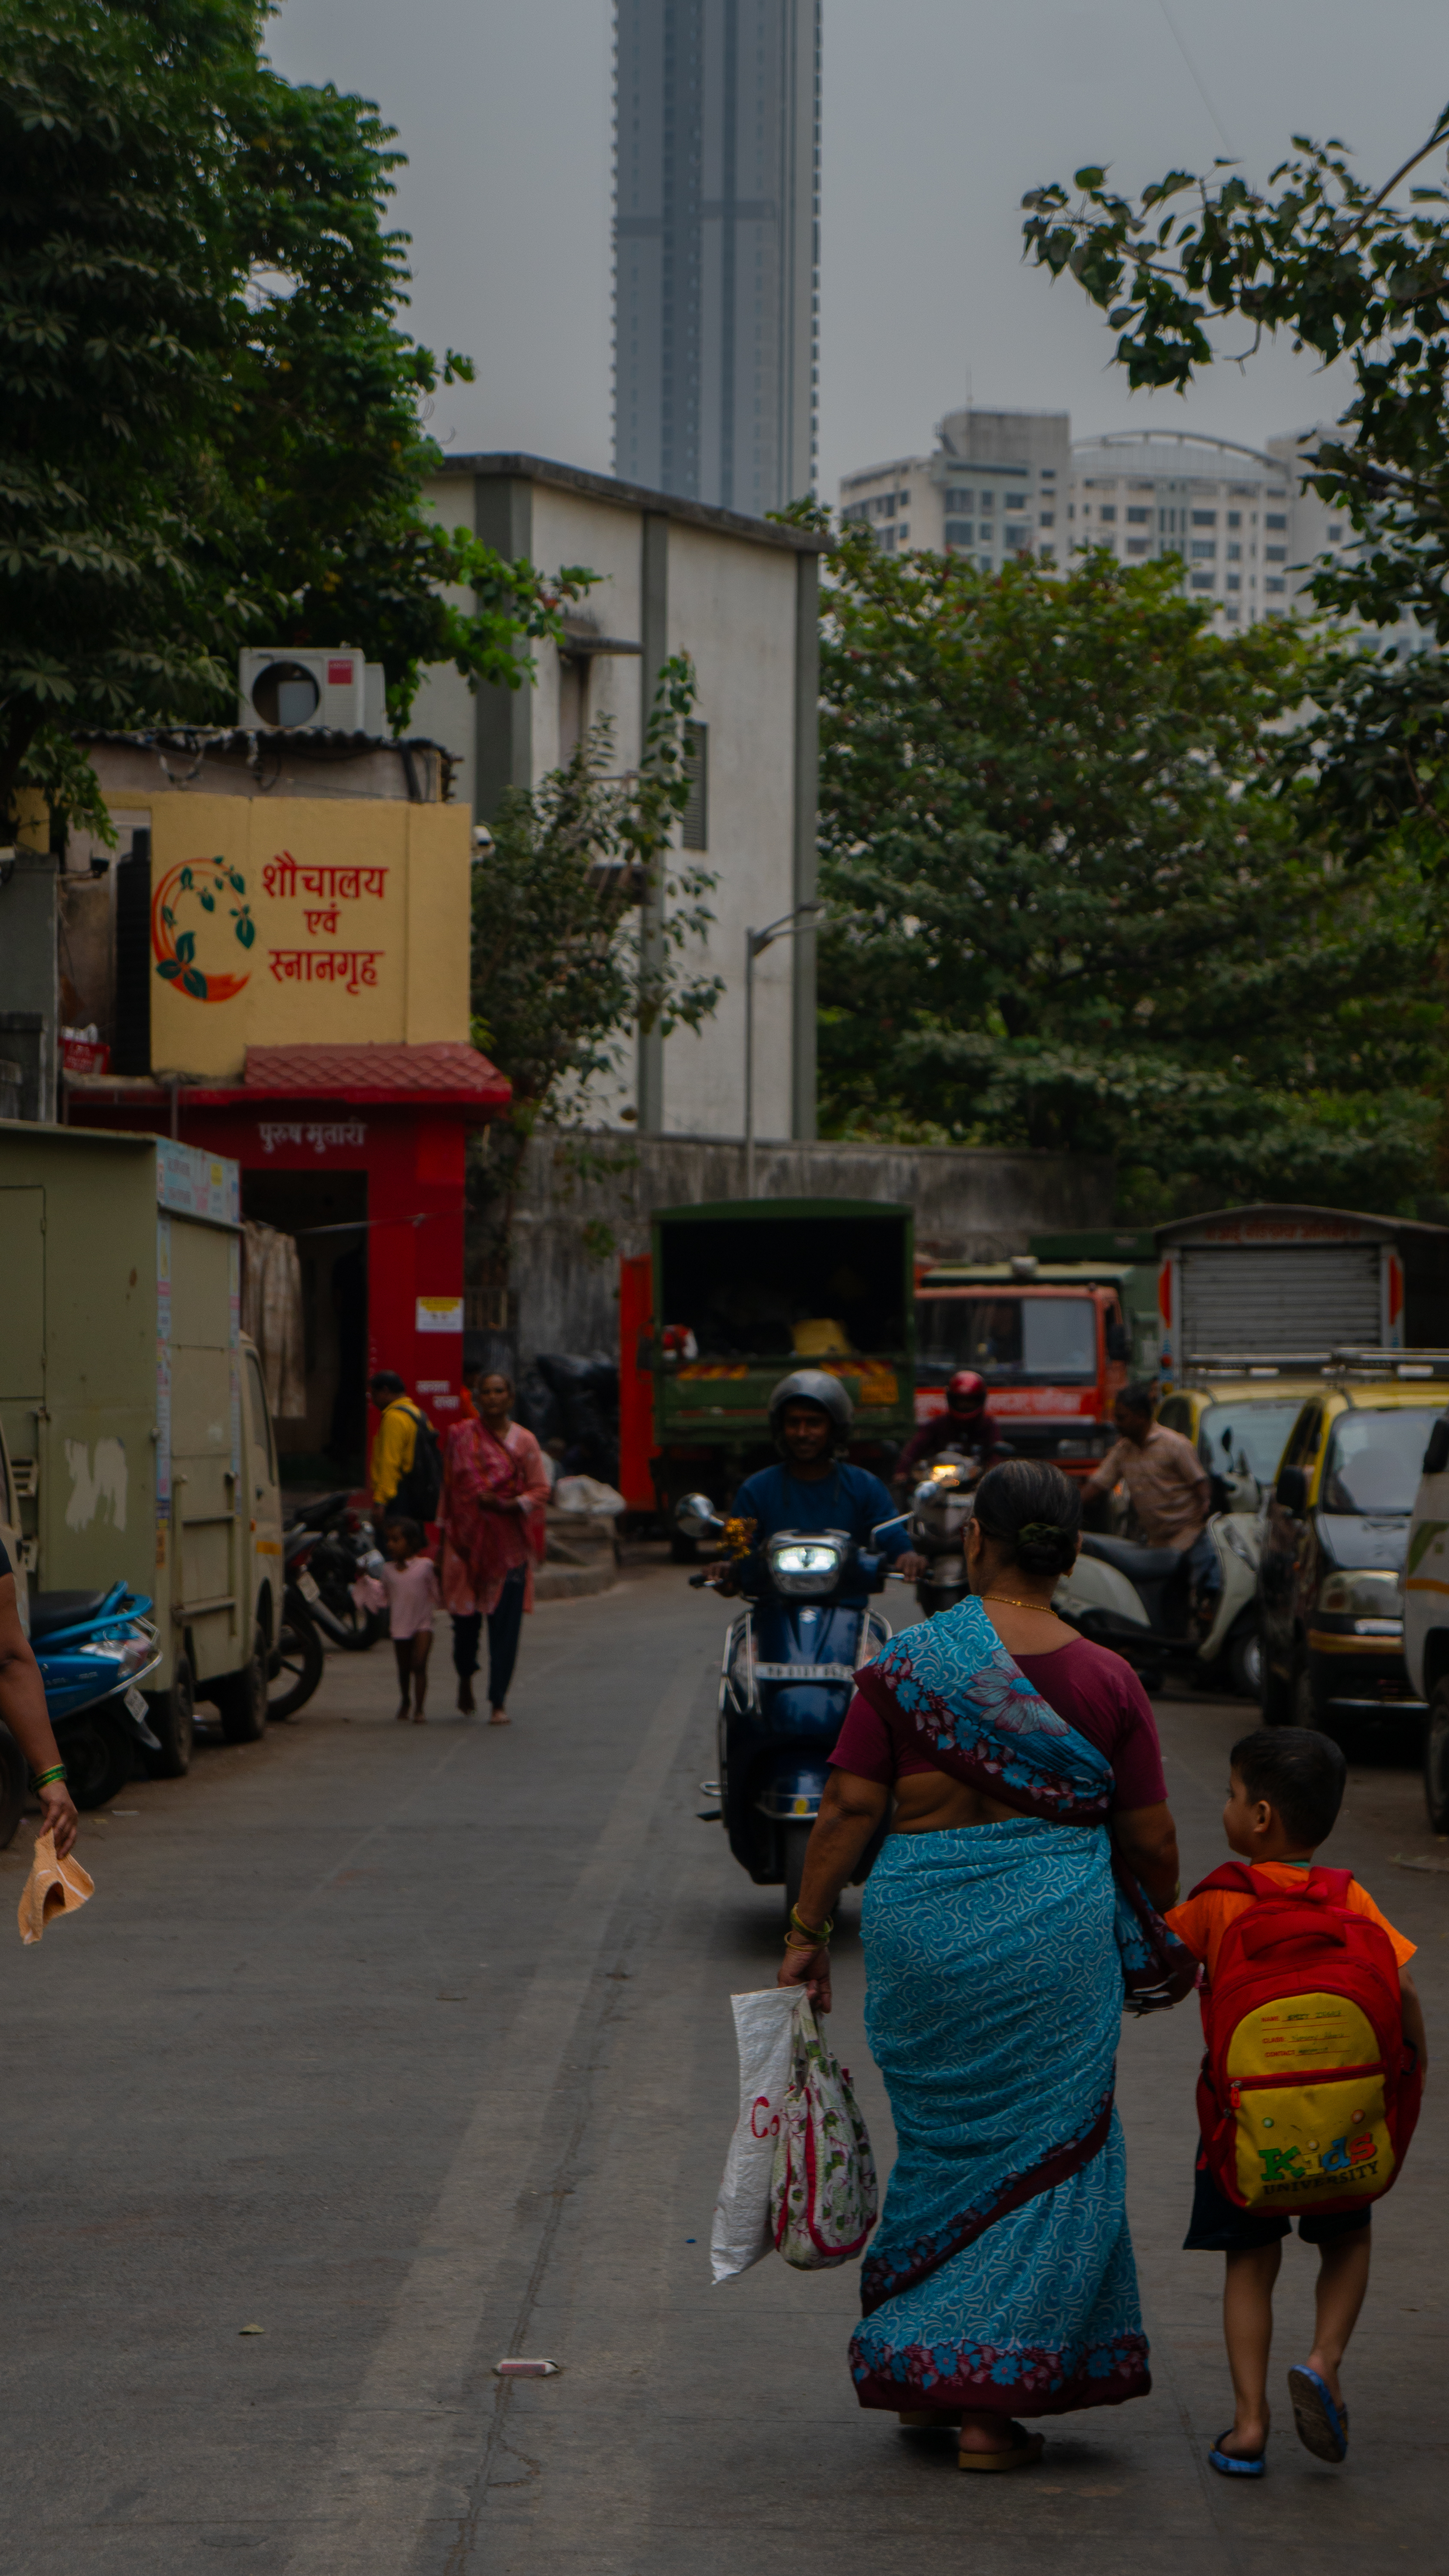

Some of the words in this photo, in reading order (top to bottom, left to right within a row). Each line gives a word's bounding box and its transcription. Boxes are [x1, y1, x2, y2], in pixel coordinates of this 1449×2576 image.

[263, 850, 389, 898] शौचालय
[302, 902, 342, 935] एवं
[268, 949, 385, 995] स्नानगृह
[1258, 2132, 1376, 2181] Kids
[1263, 2160, 1378, 2195] UNIVERSITY
